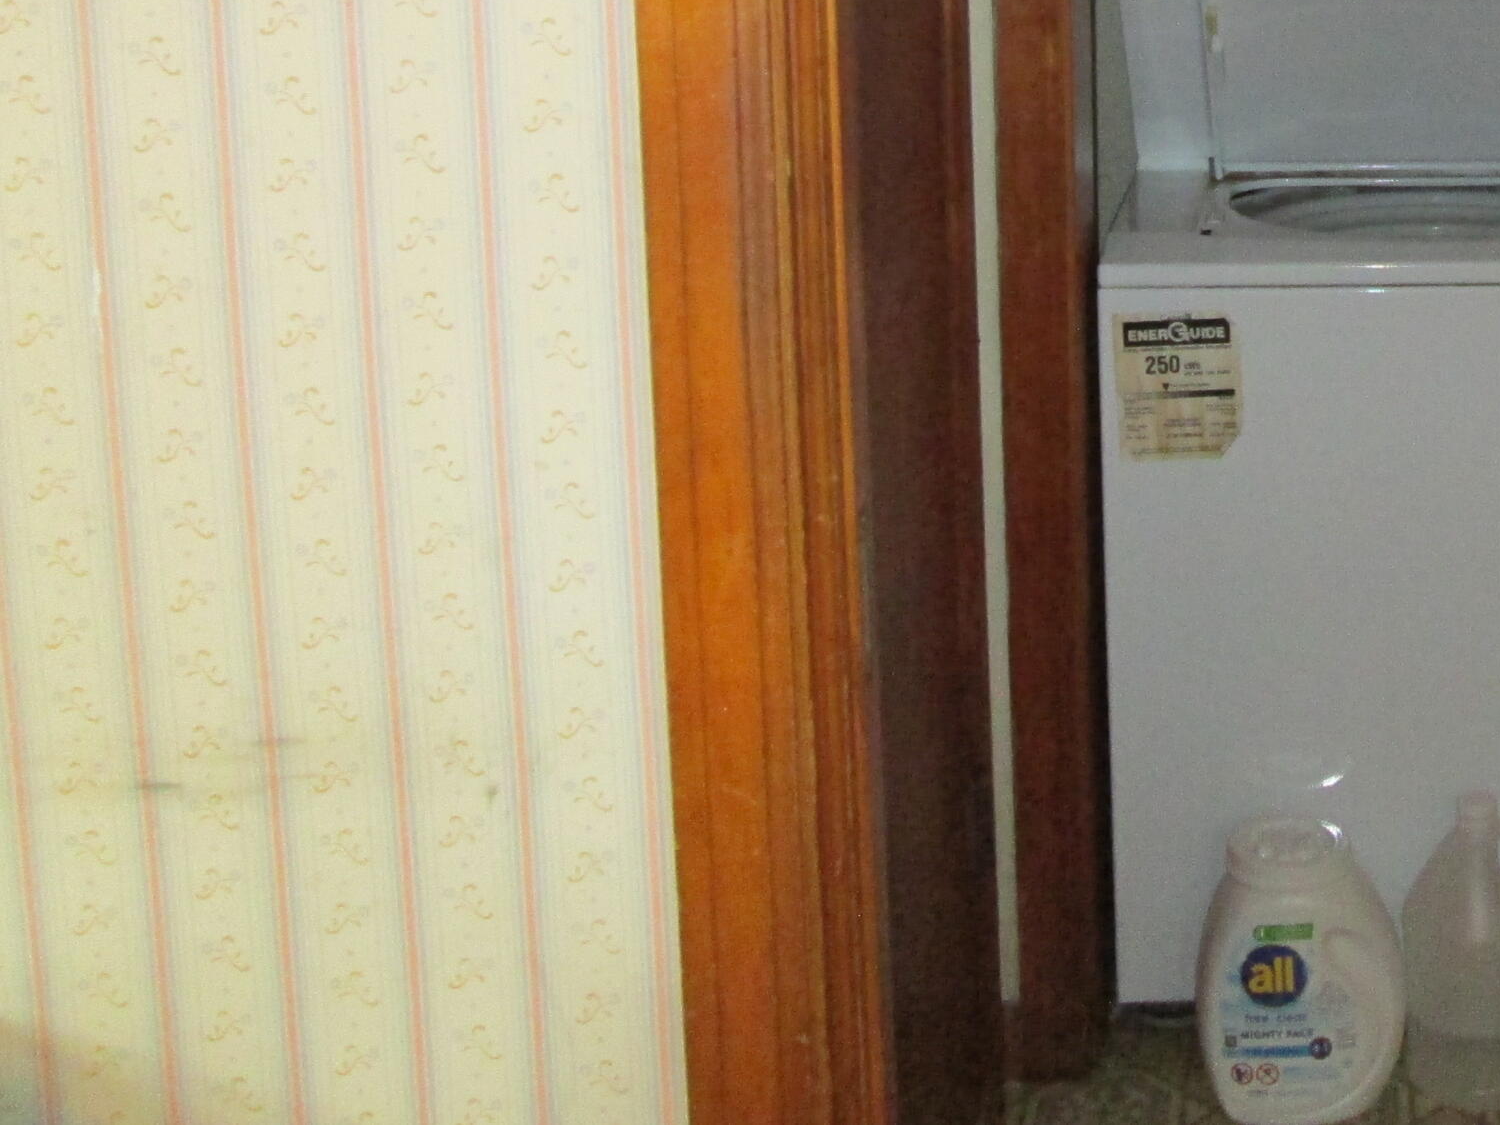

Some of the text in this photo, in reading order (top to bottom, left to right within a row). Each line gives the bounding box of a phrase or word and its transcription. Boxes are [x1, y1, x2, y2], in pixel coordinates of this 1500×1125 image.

[1126, 321, 1226, 343] ENERGUIDE
[1144, 355, 1181, 375] 250
[1249, 956, 1295, 994] all
